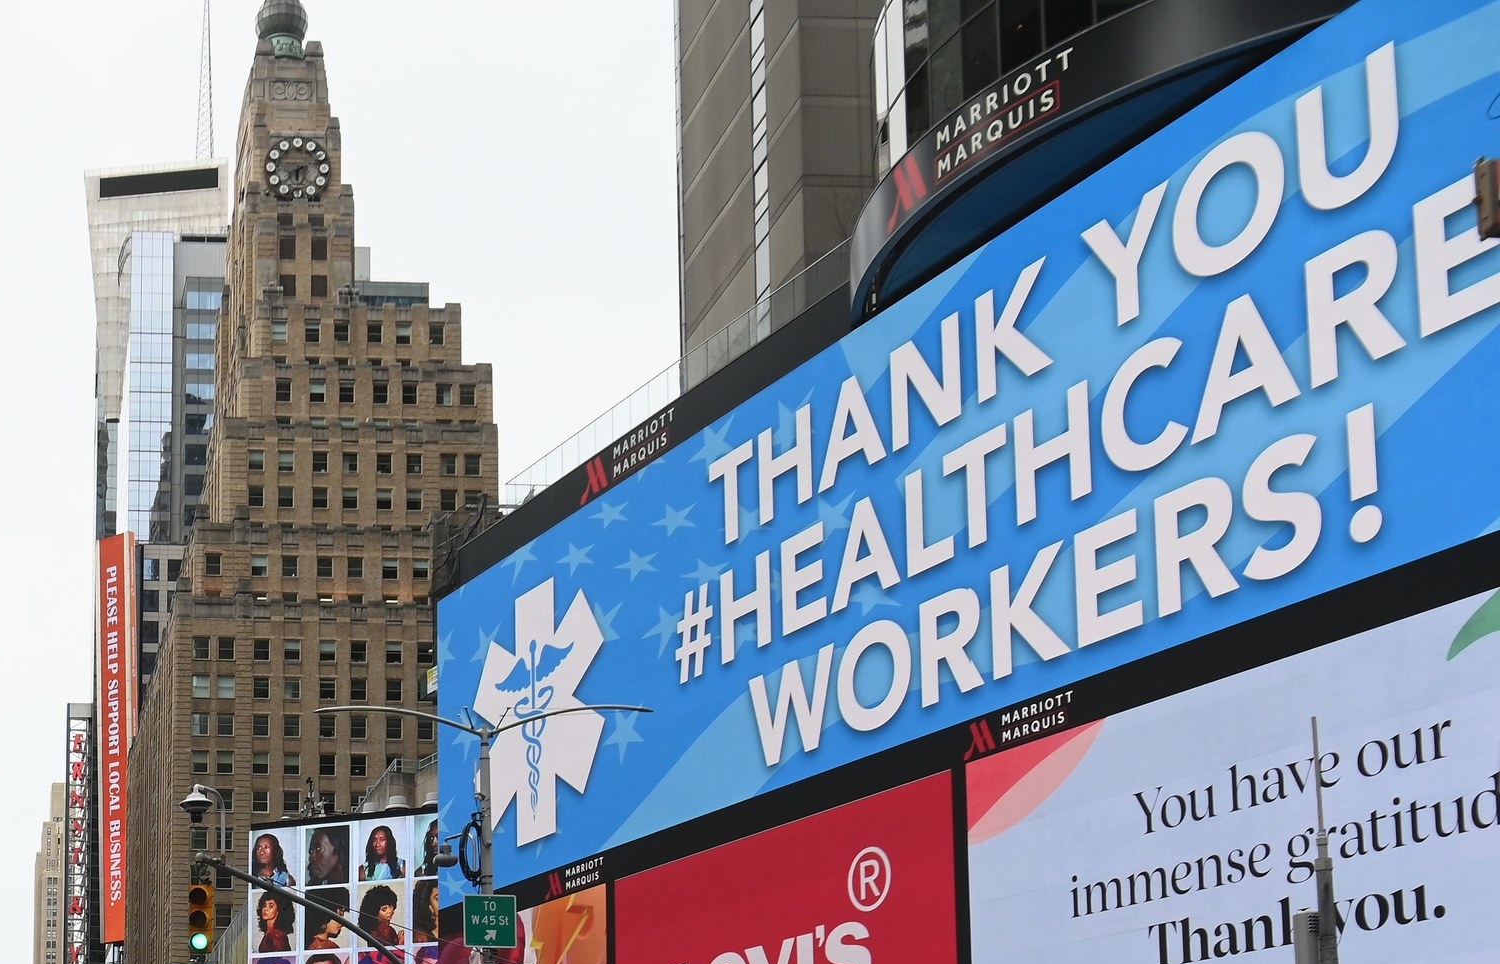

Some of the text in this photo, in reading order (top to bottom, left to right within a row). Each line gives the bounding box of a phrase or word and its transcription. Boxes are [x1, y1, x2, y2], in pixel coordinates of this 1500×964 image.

[934, 47, 1073, 152] MARRIOTT
[934, 88, 1056, 180] MARQUIS
[707, 40, 1401, 545] THANK YOU
[611, 407, 675, 460] MARRIOTT
[612, 429, 670, 479] MARQUIS
[674, 174, 1500, 684] #HEALTHCARE
[748, 402, 1383, 768] WORKERS!
[106, 565, 122, 907] PLEASE HELP SUPPORT LOCAL BUSINESS.
[1001, 690, 1074, 726] MARRIOTT
[1001, 711, 1066, 743] MARQUIS
[69, 734, 85, 866] ERNST
[1133, 719, 1452, 835] You have our
[565, 856, 605, 878] MARRIOTT
[565, 871, 600, 891] MARQUIS
[1069, 842, 1272, 919] immense
[69, 895, 84, 916] &
[471, 915, 509, 926] W 45 St
[483, 901, 497, 912] TO
